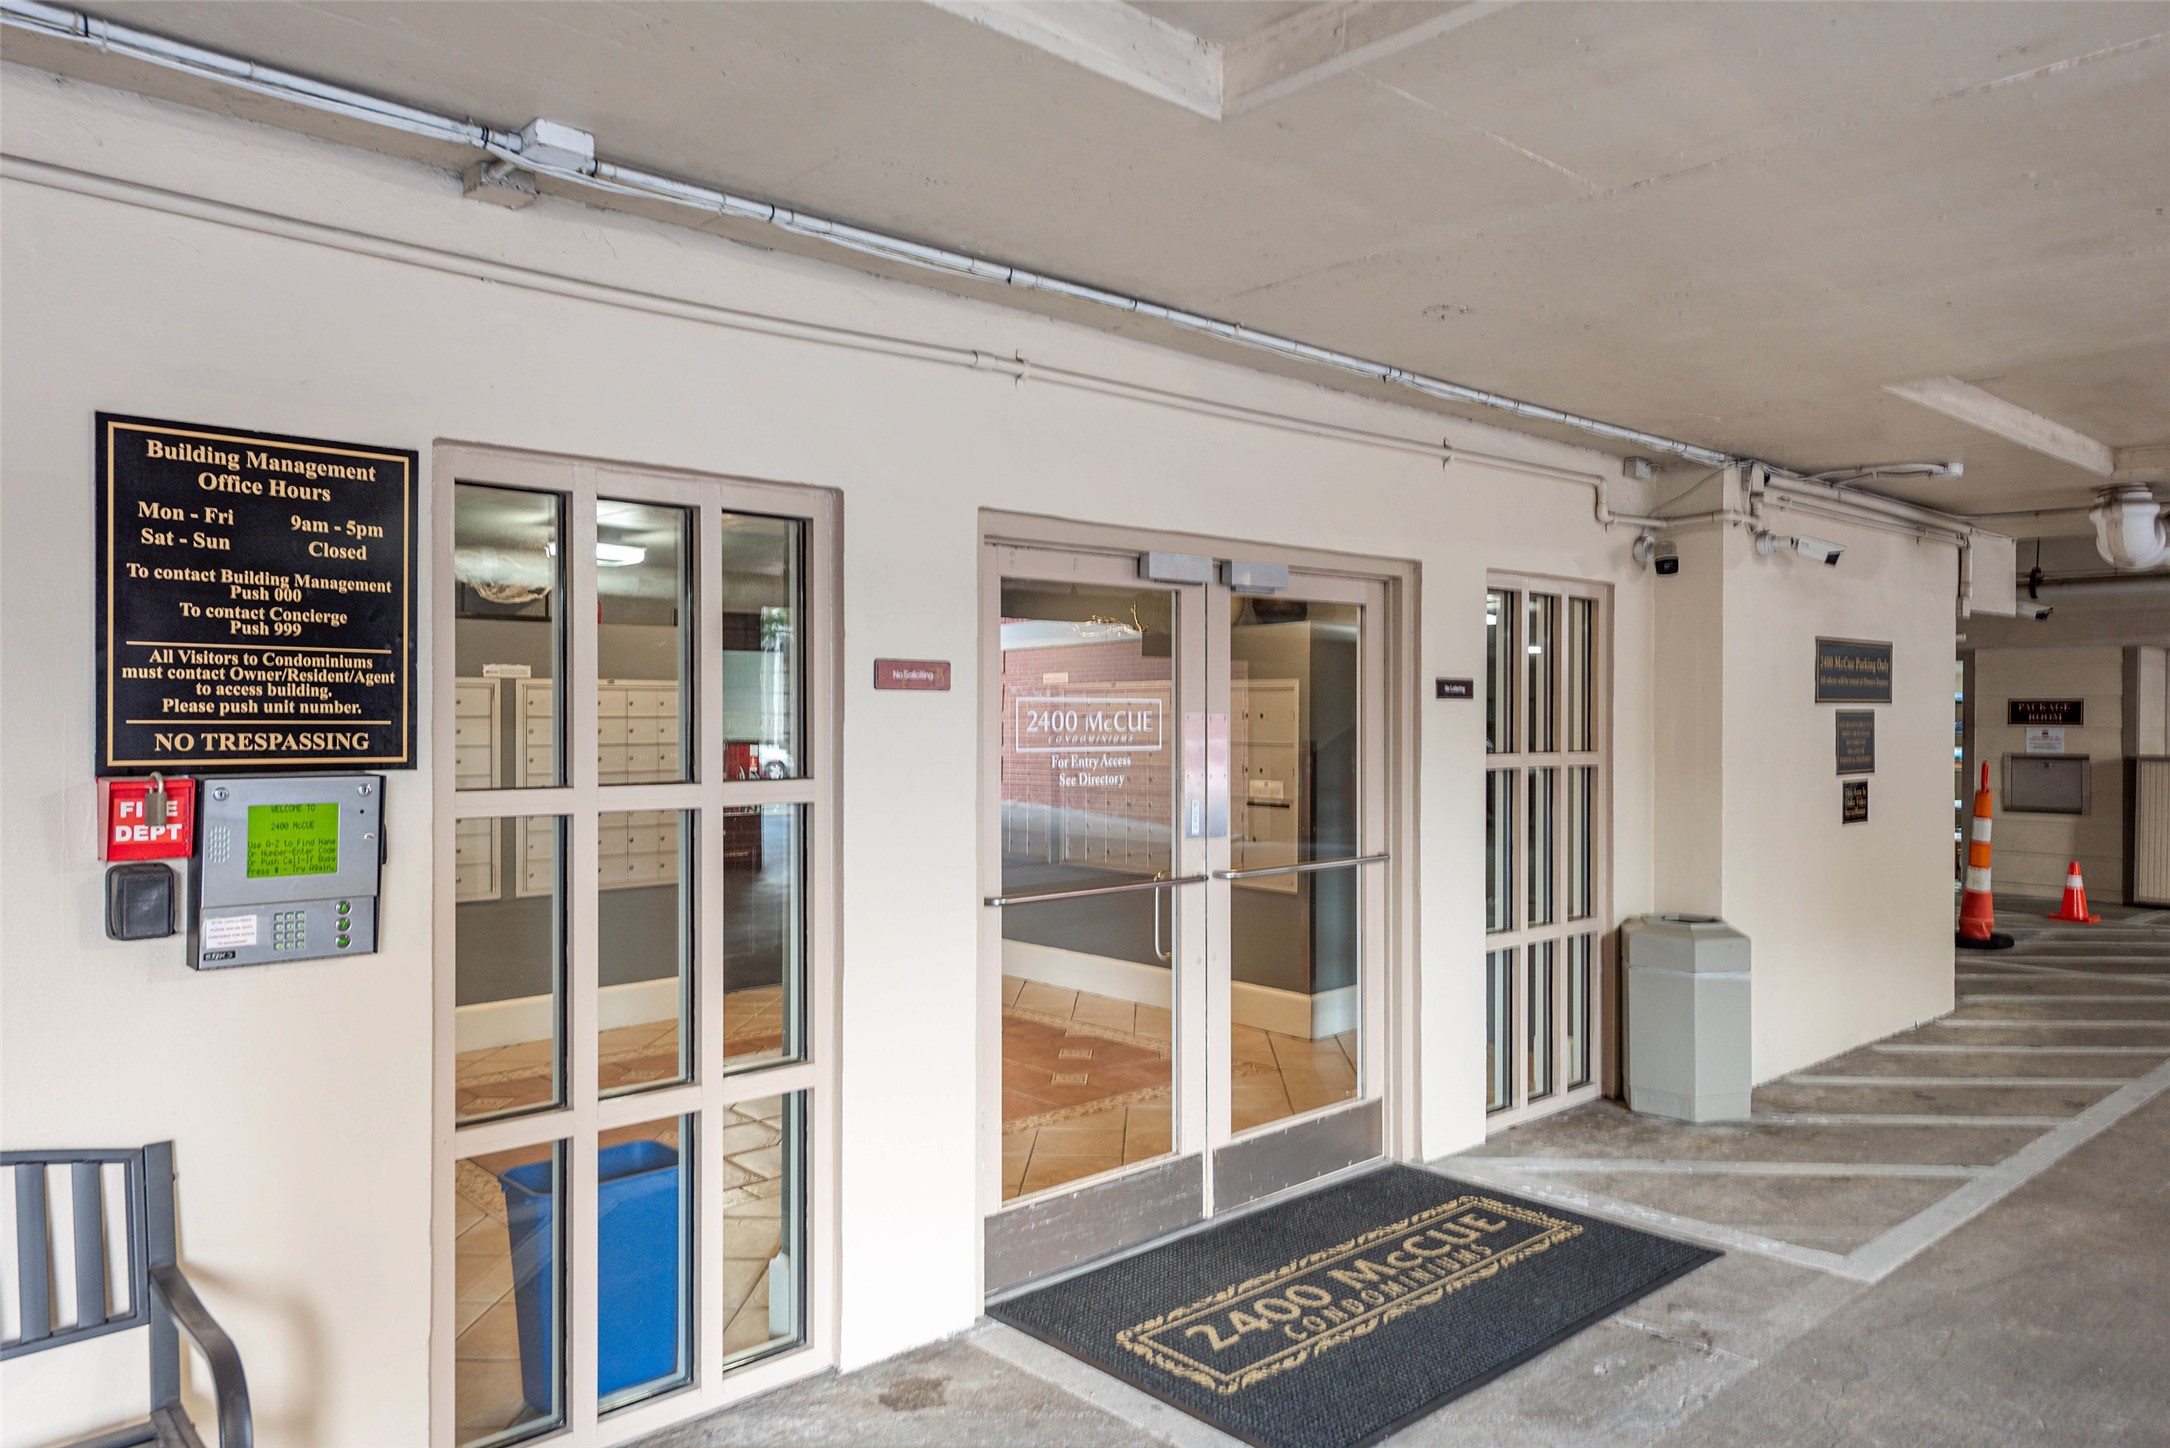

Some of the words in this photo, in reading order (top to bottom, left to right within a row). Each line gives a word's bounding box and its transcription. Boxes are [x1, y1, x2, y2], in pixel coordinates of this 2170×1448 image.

[147, 439, 239, 470] Building
[246, 450, 376, 482] Management
[198, 473, 263, 495] Office
[269, 479, 331, 502] Hours
[138, 502, 185, 520] Mon
[204, 506, 234, 525] Fri
[291, 515, 329, 533] 9am
[346, 520, 383, 539] 5pm
[141, 528, 174, 545] Sat
[193, 533, 230, 549] Sun
[309, 542, 367, 560] Closed
[127, 563, 148, 578] To
[154, 567, 216, 582] contact
[221, 569, 290, 589] Building
[294, 575, 392, 593] Management
[231, 585, 269, 600] Push
[274, 589, 301, 602] 000
[180, 603, 200, 617] To
[206, 605, 265, 620] contact
[270, 607, 347, 627] Concierge
[231, 621, 269, 635] Push
[274, 623, 301, 636] 999
[149, 650, 173, 664] All
[178, 650, 239, 665] Visitors
[244, 652, 258, 666] to
[263, 652, 373, 669] Condominiums
[1856, 656, 1876, 674] Parking
[122, 667, 163, 679] must
[168, 667, 225, 680] contact
[230, 668, 395, 686] Owner/Resident/Agent
[893, 670, 902, 680] No
[196, 683, 211, 695] to
[216, 684, 262, 696] access
[268, 684, 332, 699] building.
[163, 699, 214, 713] Please
[220, 701, 258, 716] push
[263, 700, 295, 714] unit
[300, 700, 361, 714] number.
[2018, 702, 2071, 712] PACKAGE
[1026, 710, 1077, 733] 2400
[1085, 710, 1153, 733] McCUE
[2028, 713, 2062, 722] ROOM
[155, 733, 194, 751] NO
[202, 733, 369, 750] TRESPASSING
[1048, 734, 1134, 744] CONDOMINIUMS
[1051, 754, 1069, 769] For
[1071, 753, 1099, 771] Entry
[1100, 753, 1132, 768] Access
[1059, 772, 1076, 787] See
[1079, 771, 1125, 788] Directory
[120, 801, 178, 818] FIE
[271, 804, 301, 813] WELCOME
[307, 803, 315, 812] TO
[115, 824, 182, 842] DEPT
[271, 821, 288, 831] 2400
[284, 839, 293, 848] to
[297, 838, 315, 847] Find
[261, 857, 279, 867] Push
[293, 863, 306, 872] Try
[1185, 1285, 1332, 1352] 2400
[1326, 1213, 1508, 1290] McCUE
[1284, 1243, 1492, 1341] CONDOMINIUMS
